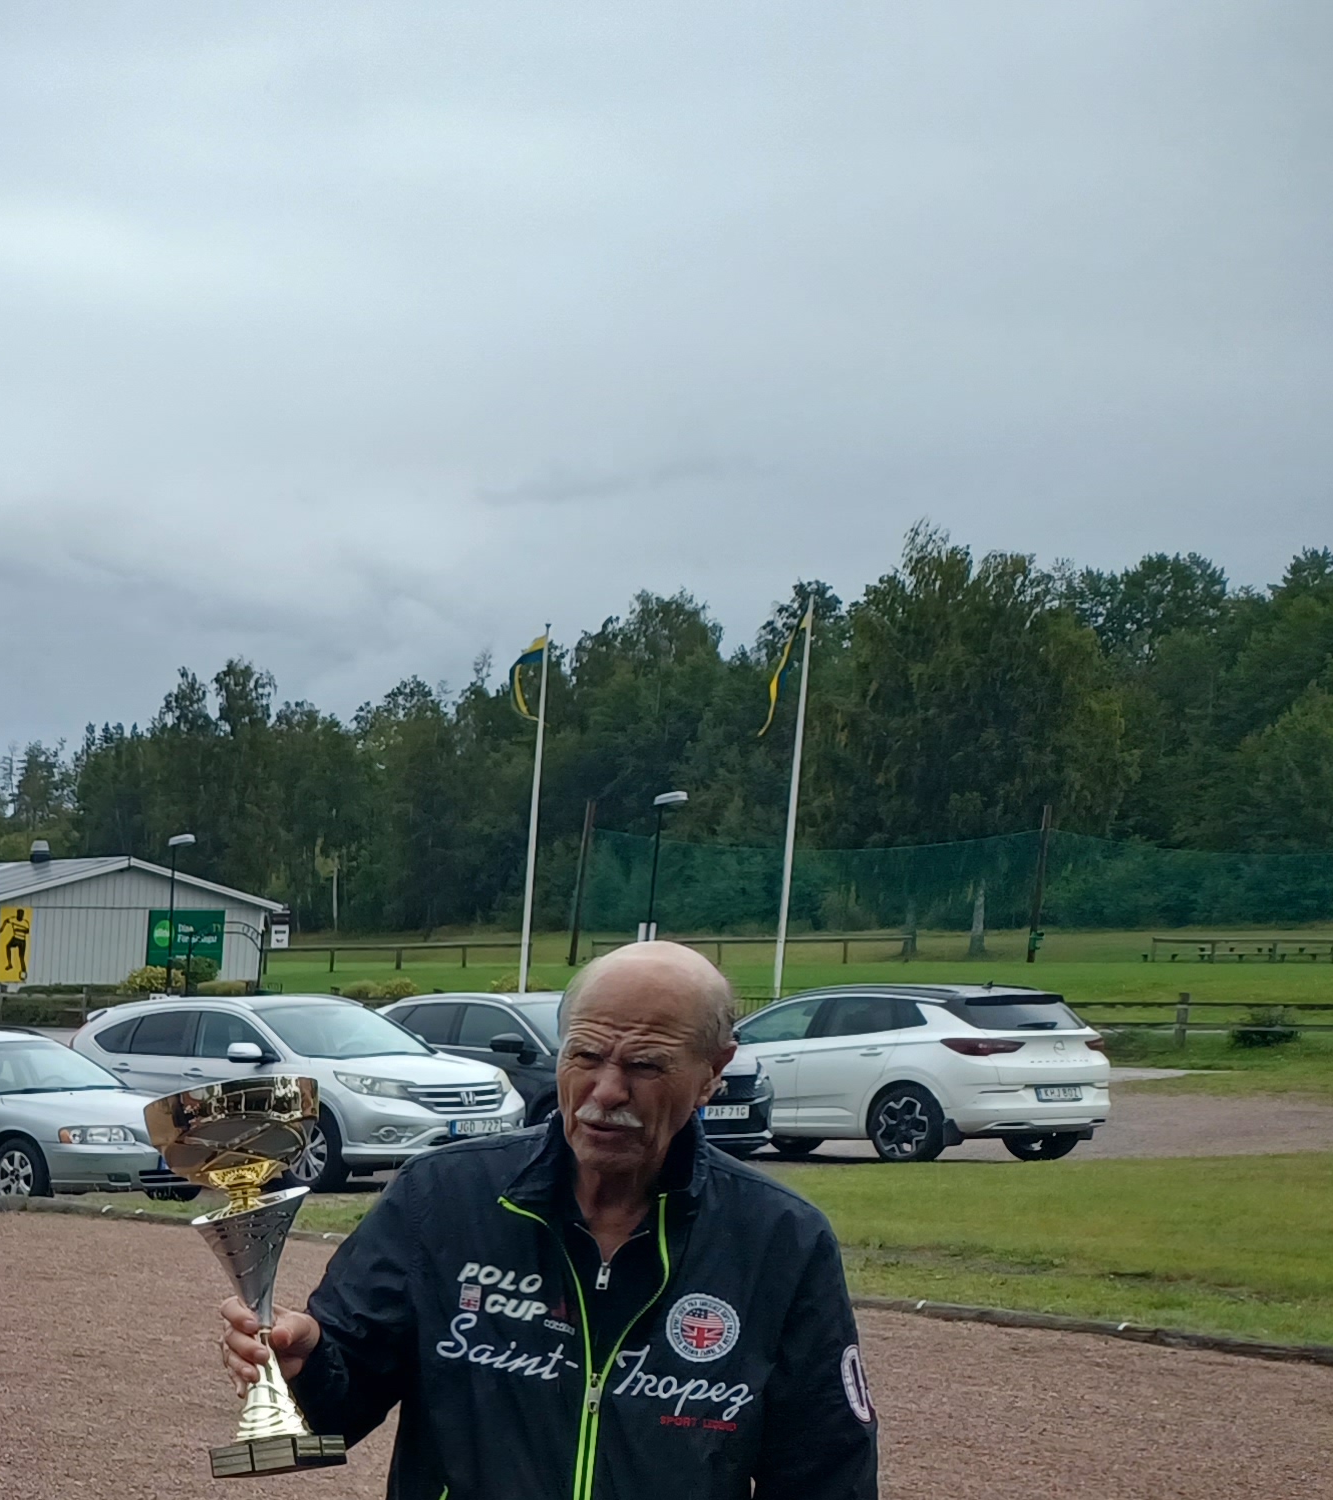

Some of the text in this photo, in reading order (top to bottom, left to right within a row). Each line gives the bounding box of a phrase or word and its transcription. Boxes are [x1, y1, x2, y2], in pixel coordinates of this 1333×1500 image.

[481, 1119, 500, 1131] 727
[707, 1106, 726, 1117] PXF
[457, 1261, 543, 1294] POLO
[484, 1293, 549, 1321] CUP
[612, 1344, 754, 1422] Tropez
